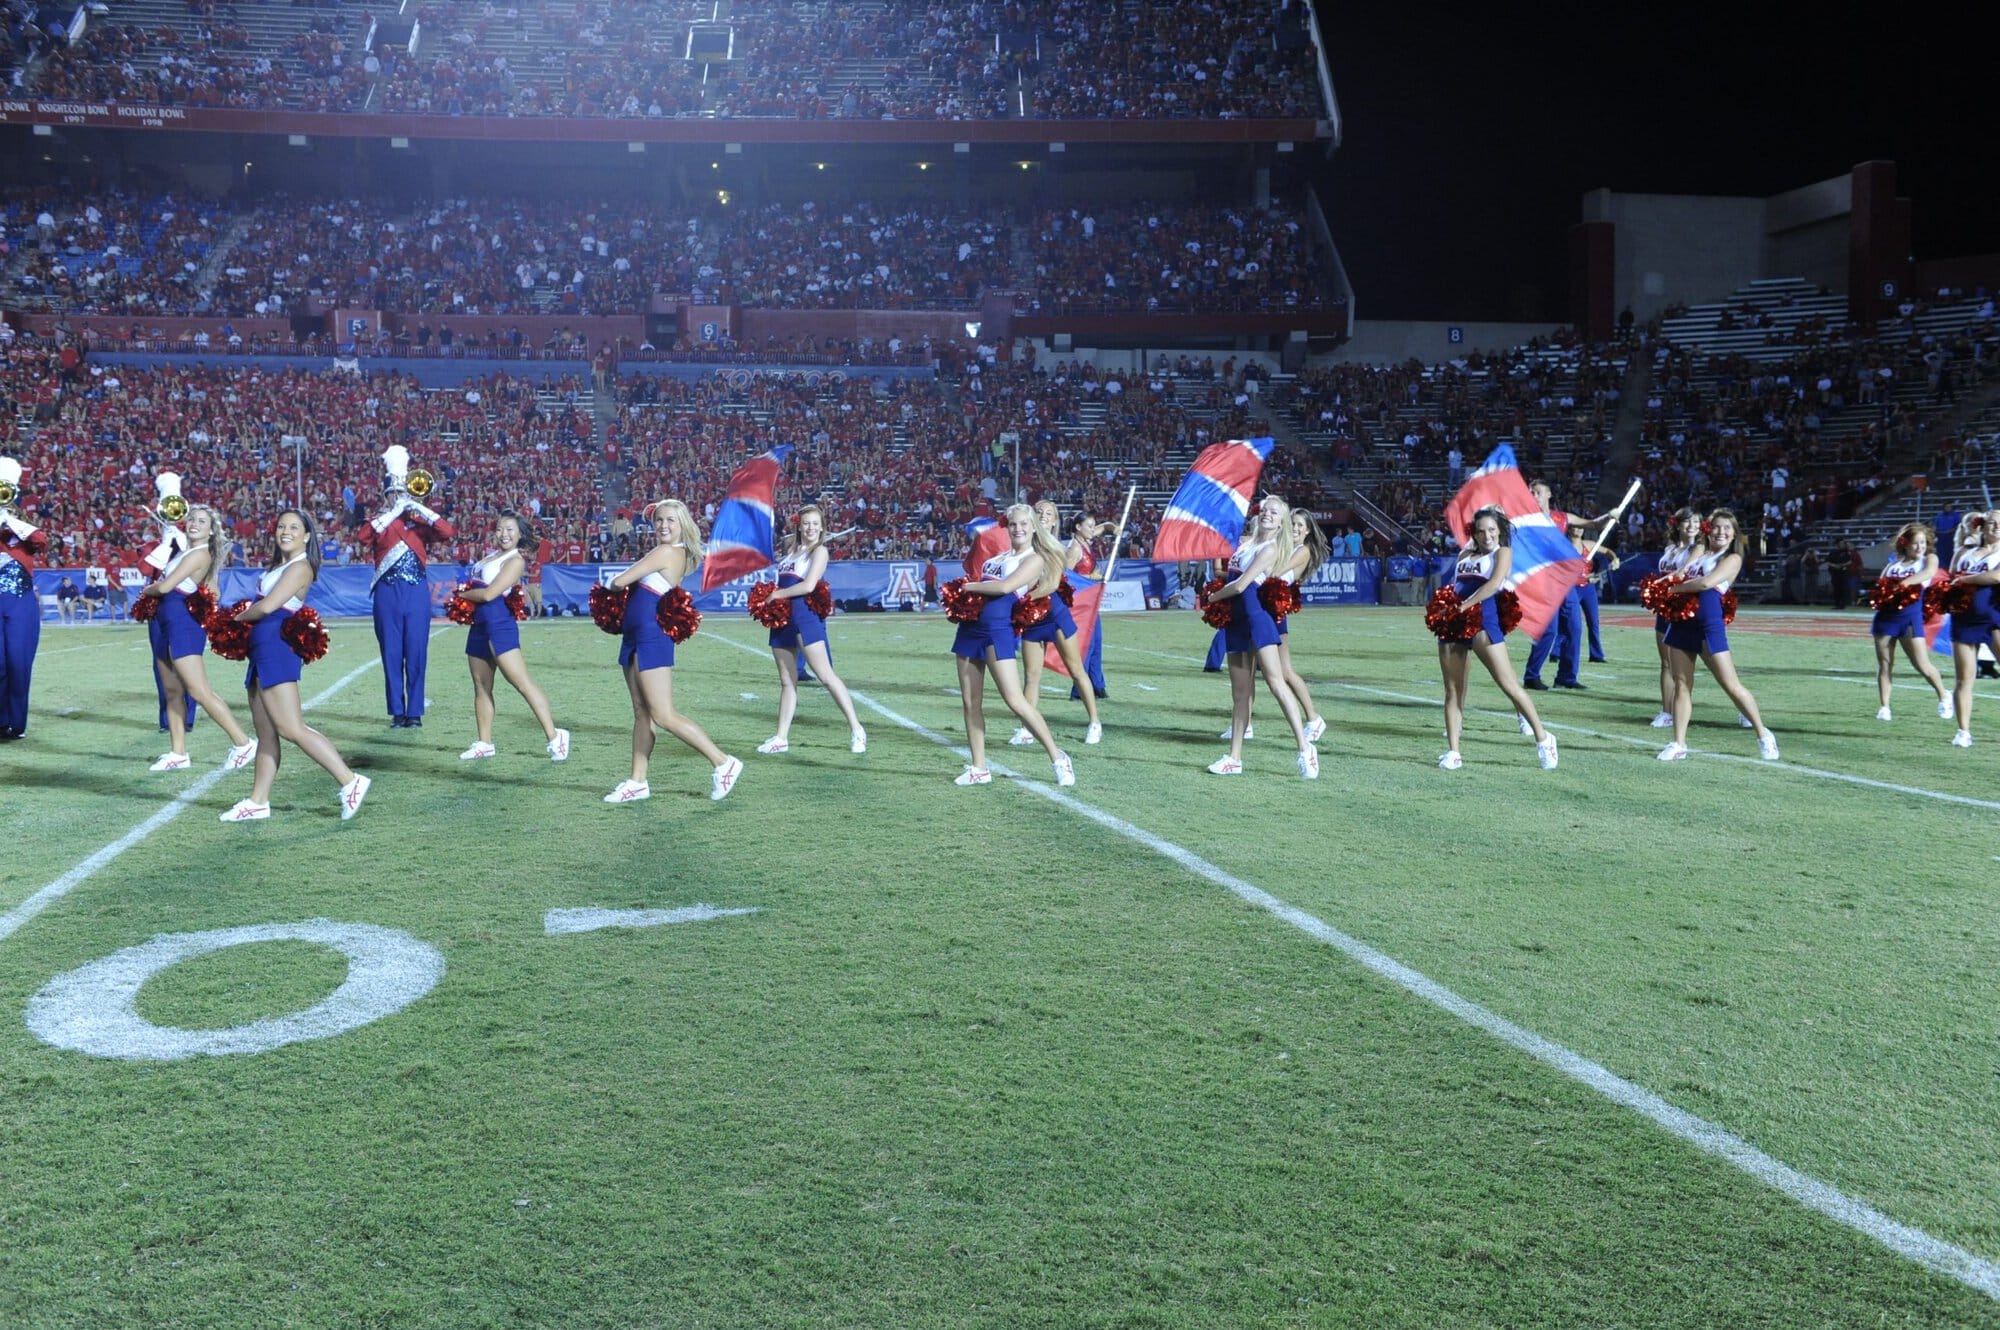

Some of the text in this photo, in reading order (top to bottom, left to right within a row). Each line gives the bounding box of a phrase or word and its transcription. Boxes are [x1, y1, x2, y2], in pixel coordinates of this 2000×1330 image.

[4, 101, 31, 112] BOWL
[88, 105, 109, 115] BOWL
[117, 106, 186, 119] HOLIDAY BOWL
[1884, 283, 1893, 296] 9
[352, 319, 362, 336] 5
[704, 323, 713, 335] 6
[1451, 329, 1460, 341] 8
